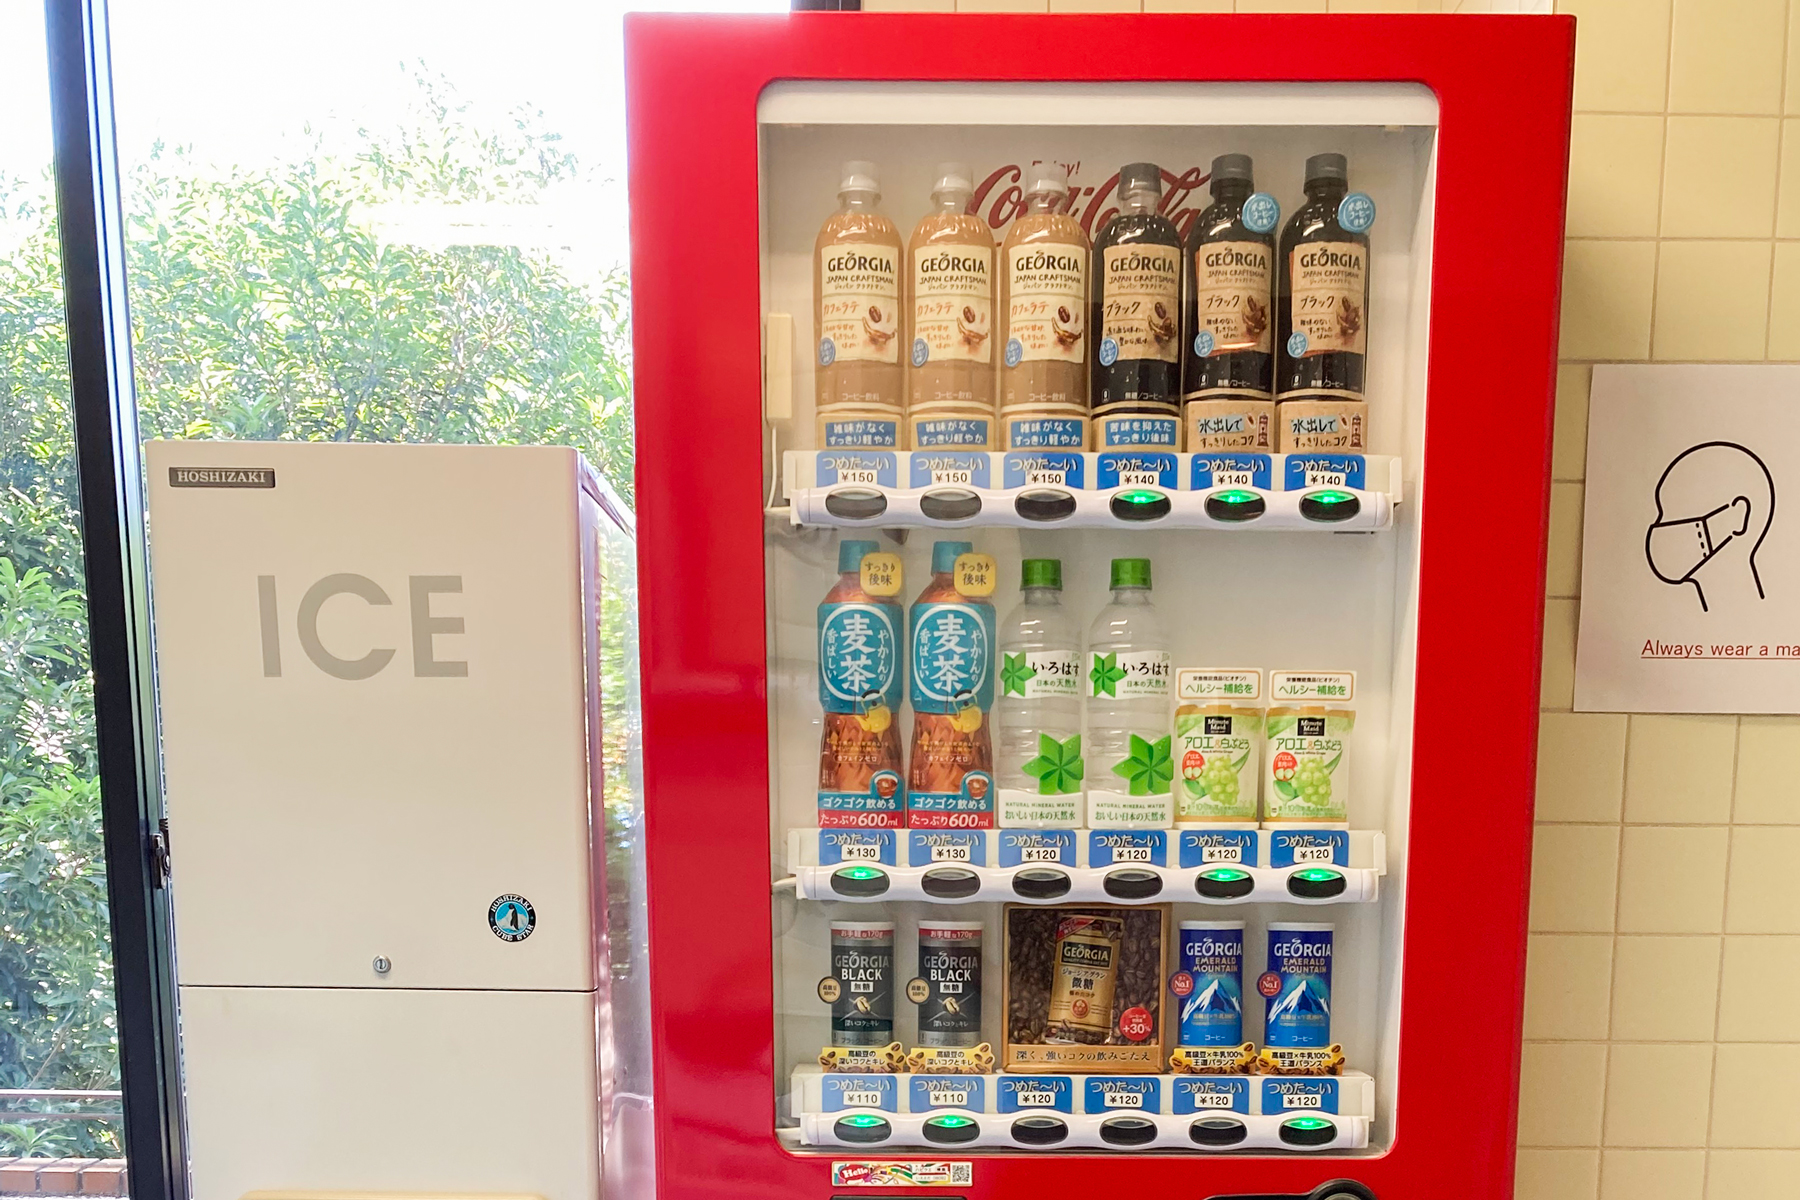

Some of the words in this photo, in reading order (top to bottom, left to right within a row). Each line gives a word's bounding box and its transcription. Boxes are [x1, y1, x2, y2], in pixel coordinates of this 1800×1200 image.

[828, 251, 892, 272] GEORGIA
[921, 251, 985, 273] GEORGIA
[1016, 250, 1079, 272] GEORGIA
[1110, 251, 1174, 273] GEORGIA
[1206, 246, 1266, 268] GEORGIA
[1300, 247, 1361, 268] GEORGIA
[1207, 270, 1225, 278] JAPAN
[1302, 270, 1321, 278] JAPAN
[1206, 295, 1240, 309] ブラック
[1300, 295, 1335, 309] ブラック
[1106, 300, 1140, 316] ブラック
[1110, 421, 1171, 432] 苦味を抑えた
[1198, 417, 1243, 432] 水出しで
[1291, 417, 1336, 433] 水出しで
[829, 434, 893, 446] すっきり軽やか
[922, 434, 984, 445] すっきり軽やか
[1015, 434, 1081, 446] すっきり軽やか
[1113, 433, 1169, 444] すっきり後味
[177, 471, 265, 482] HOSHIZAKI
[841, 472, 874, 483] ¥150
[936, 472, 968, 483] ¥150
[1031, 473, 1062, 484] ¥150
[1124, 474, 1155, 485] ¥140
[1217, 474, 1248, 485] ¥140
[1310, 475, 1342, 486] ¥140
[865, 562, 896, 573] すっきり
[959, 562, 989, 573] すっきり
[869, 574, 891, 586] 後味
[963, 574, 987, 586] 後味
[257, 573, 468, 680] ICE
[827, 629, 836, 679] 香ばしい
[840, 614, 876, 692] 麦茶
[919, 629, 929, 678] 香ばしい
[933, 614, 968, 692] 麦茶
[1642, 639, 1703, 658] Always
[1711, 645, 1752, 655] wear
[1759, 645, 1768, 655] a
[877, 630, 889, 682] やかんの
[970, 630, 982, 683] やかんの
[1186, 683, 1253, 695] ヘルシー補給を
[1278, 685, 1346, 696] ヘルシー補給を
[823, 797, 896, 810] ゴクゴク飲める
[915, 797, 986, 810] ゴクゴク飲める
[1005, 810, 1076, 821] おいしい日本の天然水
[1095, 811, 1166, 822] おいしい日本の天然水
[847, 847, 876, 858] ¥130
[937, 848, 965, 859] ¥130
[1026, 850, 1057, 860] ¥120
[1117, 849, 1147, 860] ¥120
[1208, 849, 1237, 860] ¥120
[1300, 849, 1329, 860] ¥120
[1186, 937, 1243, 957] GEORGIA
[1274, 937, 1332, 958] GEORGIA
[835, 950, 889, 968] GEORGIA
[924, 951, 978, 968] GEORGIA
[1063, 946, 1109, 962] GEORGIA
[1195, 957, 1236, 965] EMERALD
[1283, 958, 1325, 966] EMERALD
[1193, 965, 1239, 973] MOUNTAIN
[1281, 965, 1327, 974] MOUNTAIN
[841, 969, 883, 981] BLACK
[931, 969, 972, 981] BLACK
[853, 983, 870, 992] 無糖
[942, 983, 959, 992] 無糖
[1072, 977, 1094, 990] 微糖
[848, 1050, 876, 1058] 高級豆の
[936, 1050, 964, 1058] 高級豆の
[1015, 1050, 1151, 1062] 深く、強いコクの飲みごたえ
[839, 1057, 886, 1066] 深いコクとキレ
[927, 1058, 974, 1066] 深いコクとキレ
[1193, 1059, 1235, 1067] 王道バランス
[1281, 1060, 1323, 1068] 王道バランス
[848, 1094, 878, 1104] ¥110
[934, 1093, 964, 1103] ¥110
[1023, 1094, 1051, 1104] ¥120
[1109, 1094, 1138, 1105] ¥120
[1200, 1095, 1229, 1106] ¥120
[1288, 1095, 1317, 1106] ¥120
[842, 1168, 868, 1178] Hello
